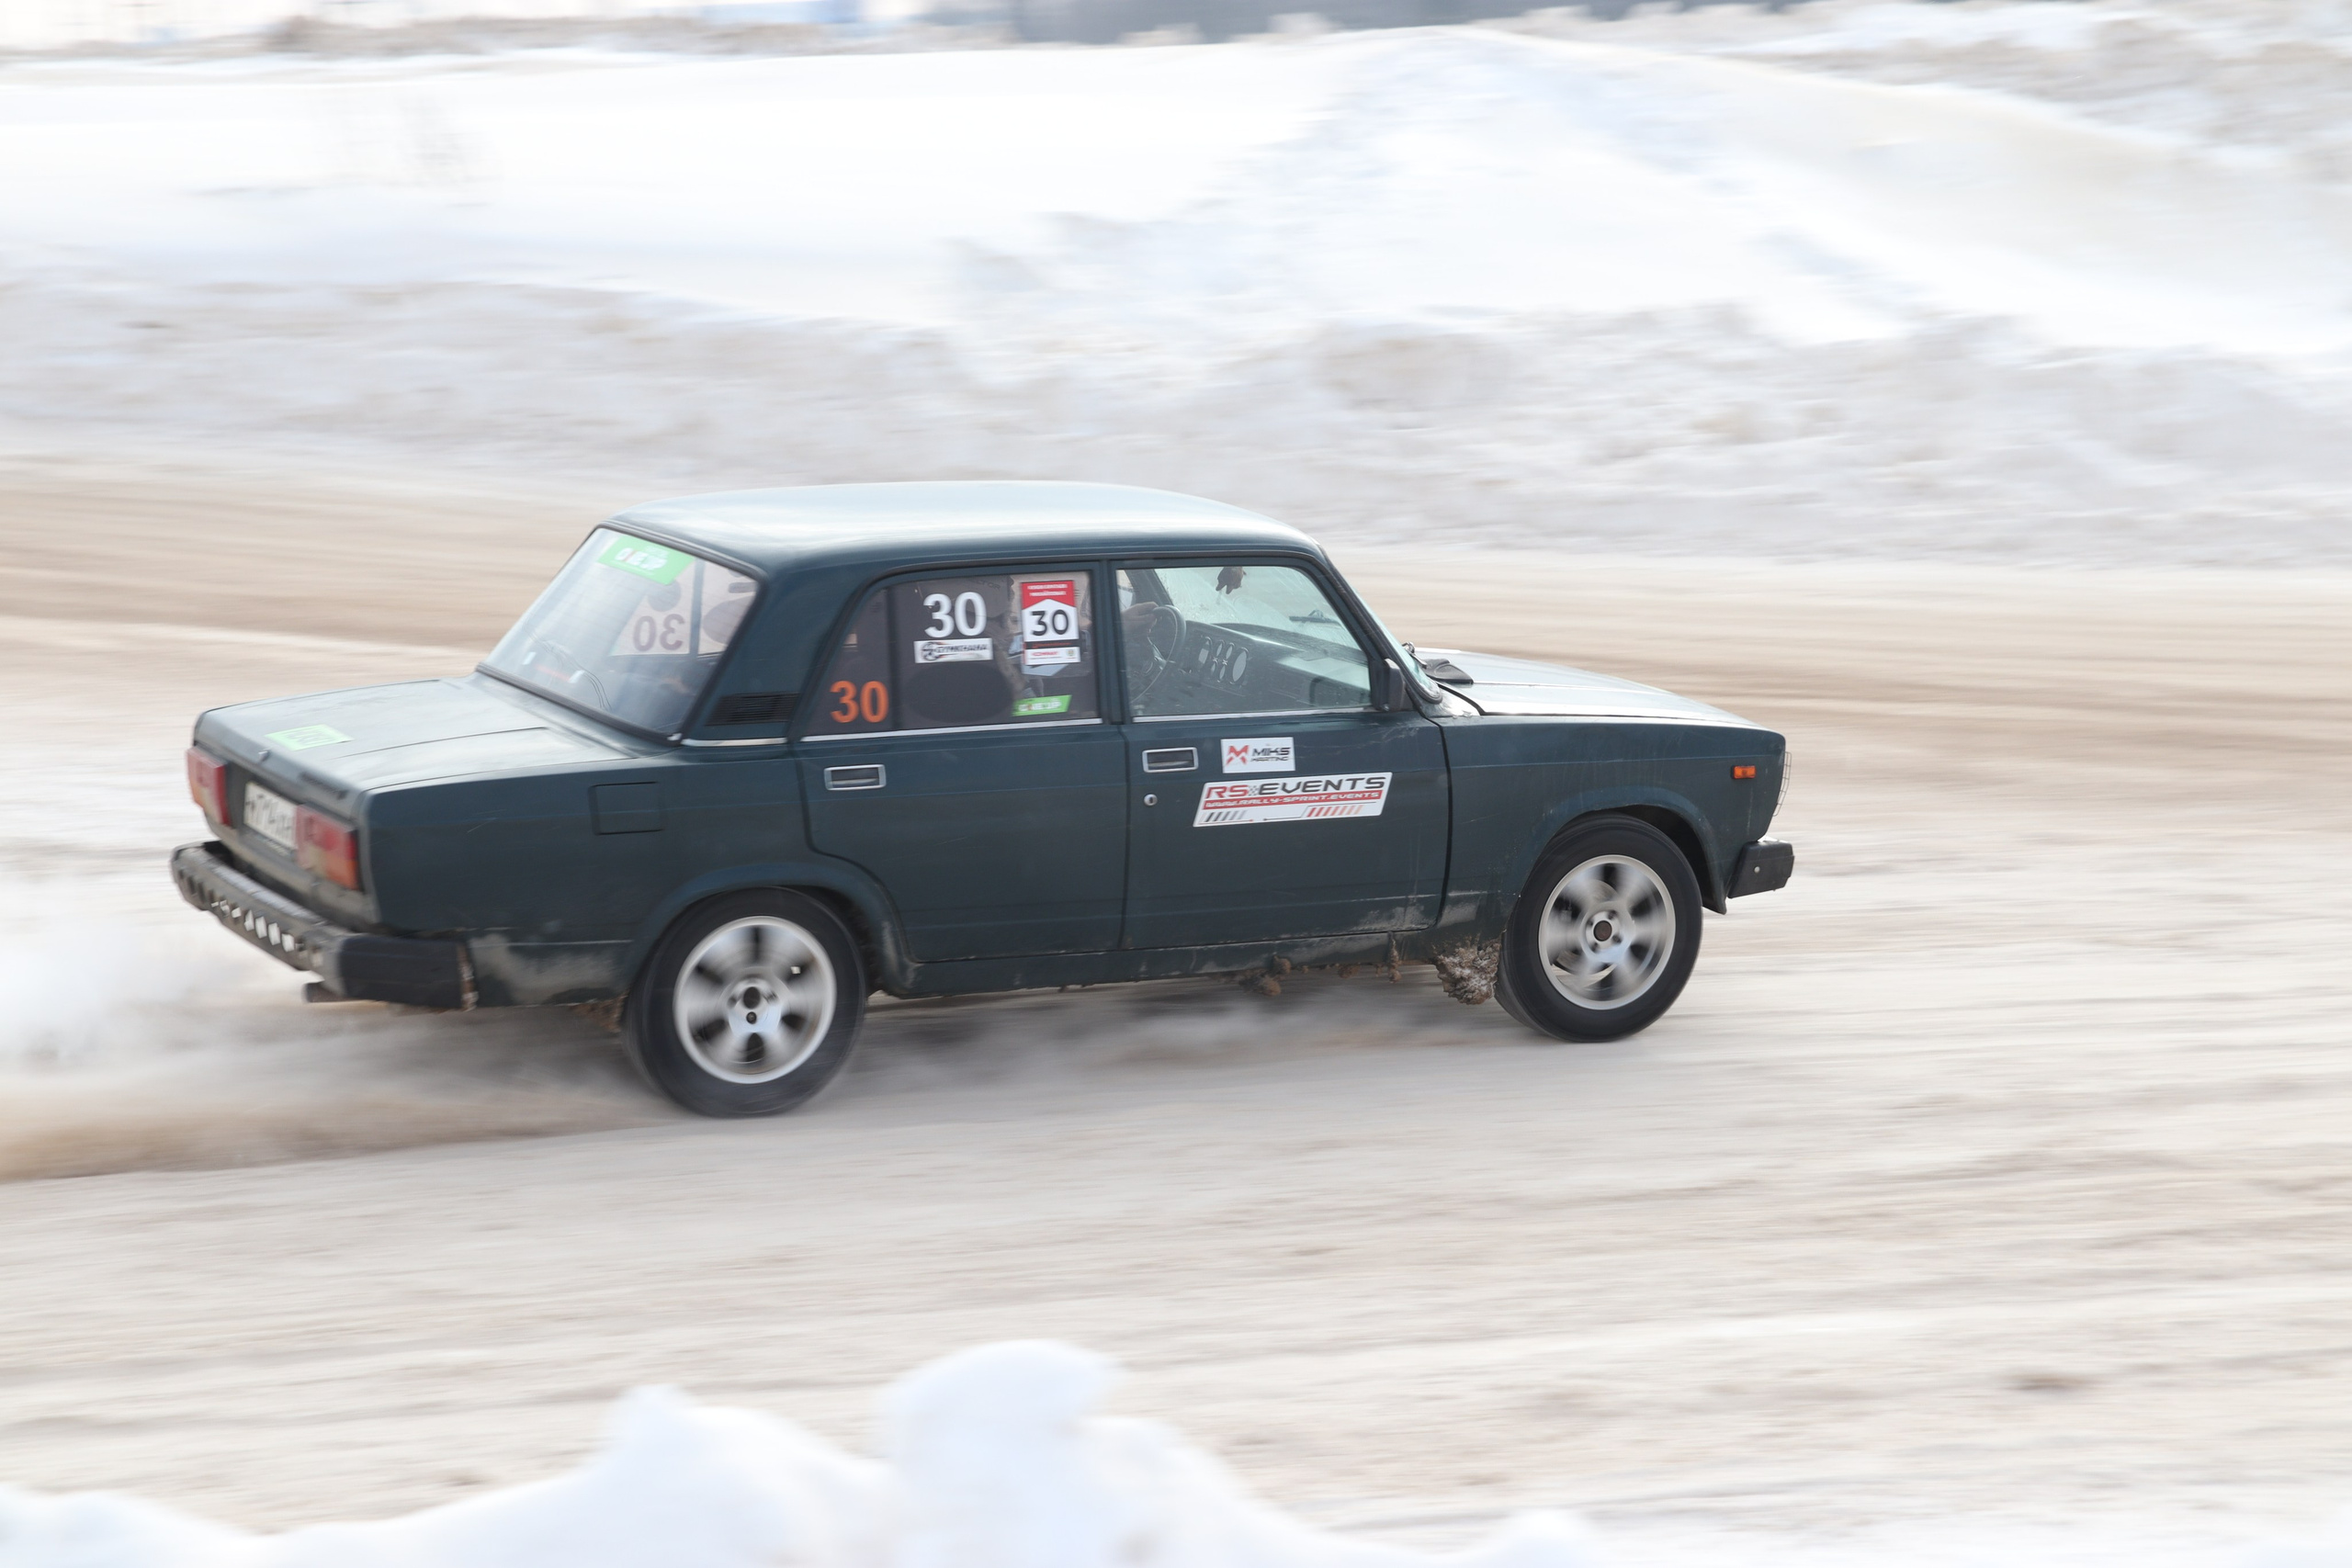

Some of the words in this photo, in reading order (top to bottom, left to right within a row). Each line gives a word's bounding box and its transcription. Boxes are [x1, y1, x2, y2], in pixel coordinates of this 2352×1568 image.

[923, 592, 987, 637] 30
[1031, 609, 1069, 636] 30
[830, 681, 889, 723] 30
[1252, 747, 1291, 757] MIKS
[1205, 784, 1249, 799] RS
[1258, 777, 1386, 795] EVENTS
